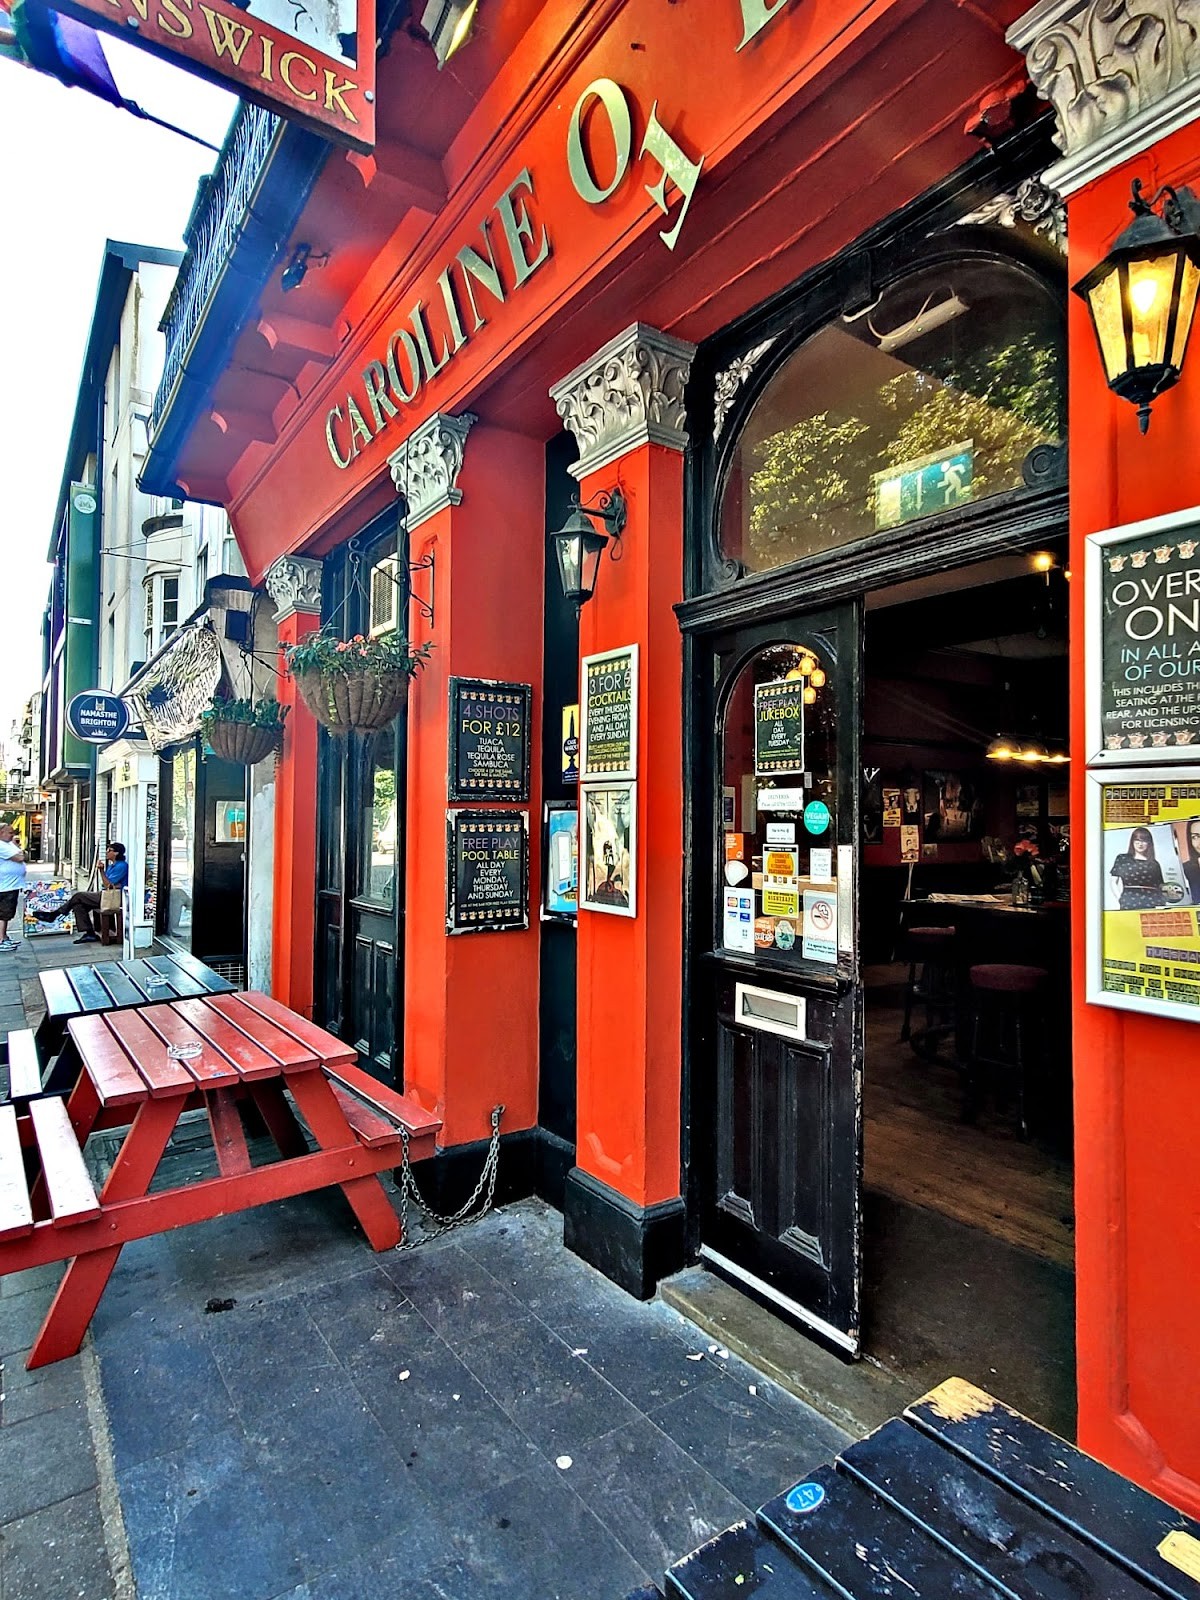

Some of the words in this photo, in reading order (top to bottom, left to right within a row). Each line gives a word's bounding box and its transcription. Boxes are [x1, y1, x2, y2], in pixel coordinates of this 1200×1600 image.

[326, 166, 551, 470] CAROLINE
[1121, 648, 1140, 663] IN
[1146, 643, 1182, 660] ALL
[1125, 664, 1153, 681] OF
[589, 680, 596, 694] 3
[599, 673, 621, 693] FOR
[1113, 688, 1131, 697] THIS
[1133, 682, 1183, 695] INCLUDES
[759, 700, 777, 711] FREE
[779, 697, 798, 708] PLAY
[1116, 696, 1157, 708] SEATING
[1160, 696, 1172, 704] AT
[1174, 693, 1195, 704] THE
[80, 709, 117, 719] NAMASTHE
[463, 704, 471, 718] 4
[475, 705, 519, 721] SHOTS
[588, 706, 604, 718] EVERY
[759, 706, 799, 722] JUKEBOX
[1135, 708, 1159, 717] AND
[1161, 706, 1180, 715] THE
[80, 717, 117, 727] BRIGHTON
[588, 713, 611, 726] EVENING
[611, 711, 627, 721] FROM
[1122, 721, 1142, 729] FOR
[1144, 716, 1200, 728] LICENSING
[462, 719, 492, 735] FOR
[495, 721, 521, 737] £12
[592, 723, 605, 733] AND
[605, 722, 615, 731] ALL
[615, 721, 628, 730] DAY
[478, 737, 504, 746] TUACA
[590, 731, 607, 742] EVERY
[607, 729, 629, 741] SUNDAY
[476, 745, 505, 754] TEQUILA
[467, 751, 495, 761] TEQUILA
[497, 752, 515, 761] ROSE
[473, 760, 509, 769] SAMBUCA
[1106, 788, 1166, 799] PREVIEWS
[462, 838, 488, 850] FREE
[491, 837, 518, 849] PLAY
[462, 850, 490, 860] POOL
[492, 850, 519, 860] TABLE
[476, 861, 488, 869] ALL
[490, 861, 505, 869] DAY
[480, 868, 501, 877] EVERY
[473, 883, 508, 892] THURSDAY
[467, 892, 484, 900] AND
[485, 890, 513, 899] SUNDAY
